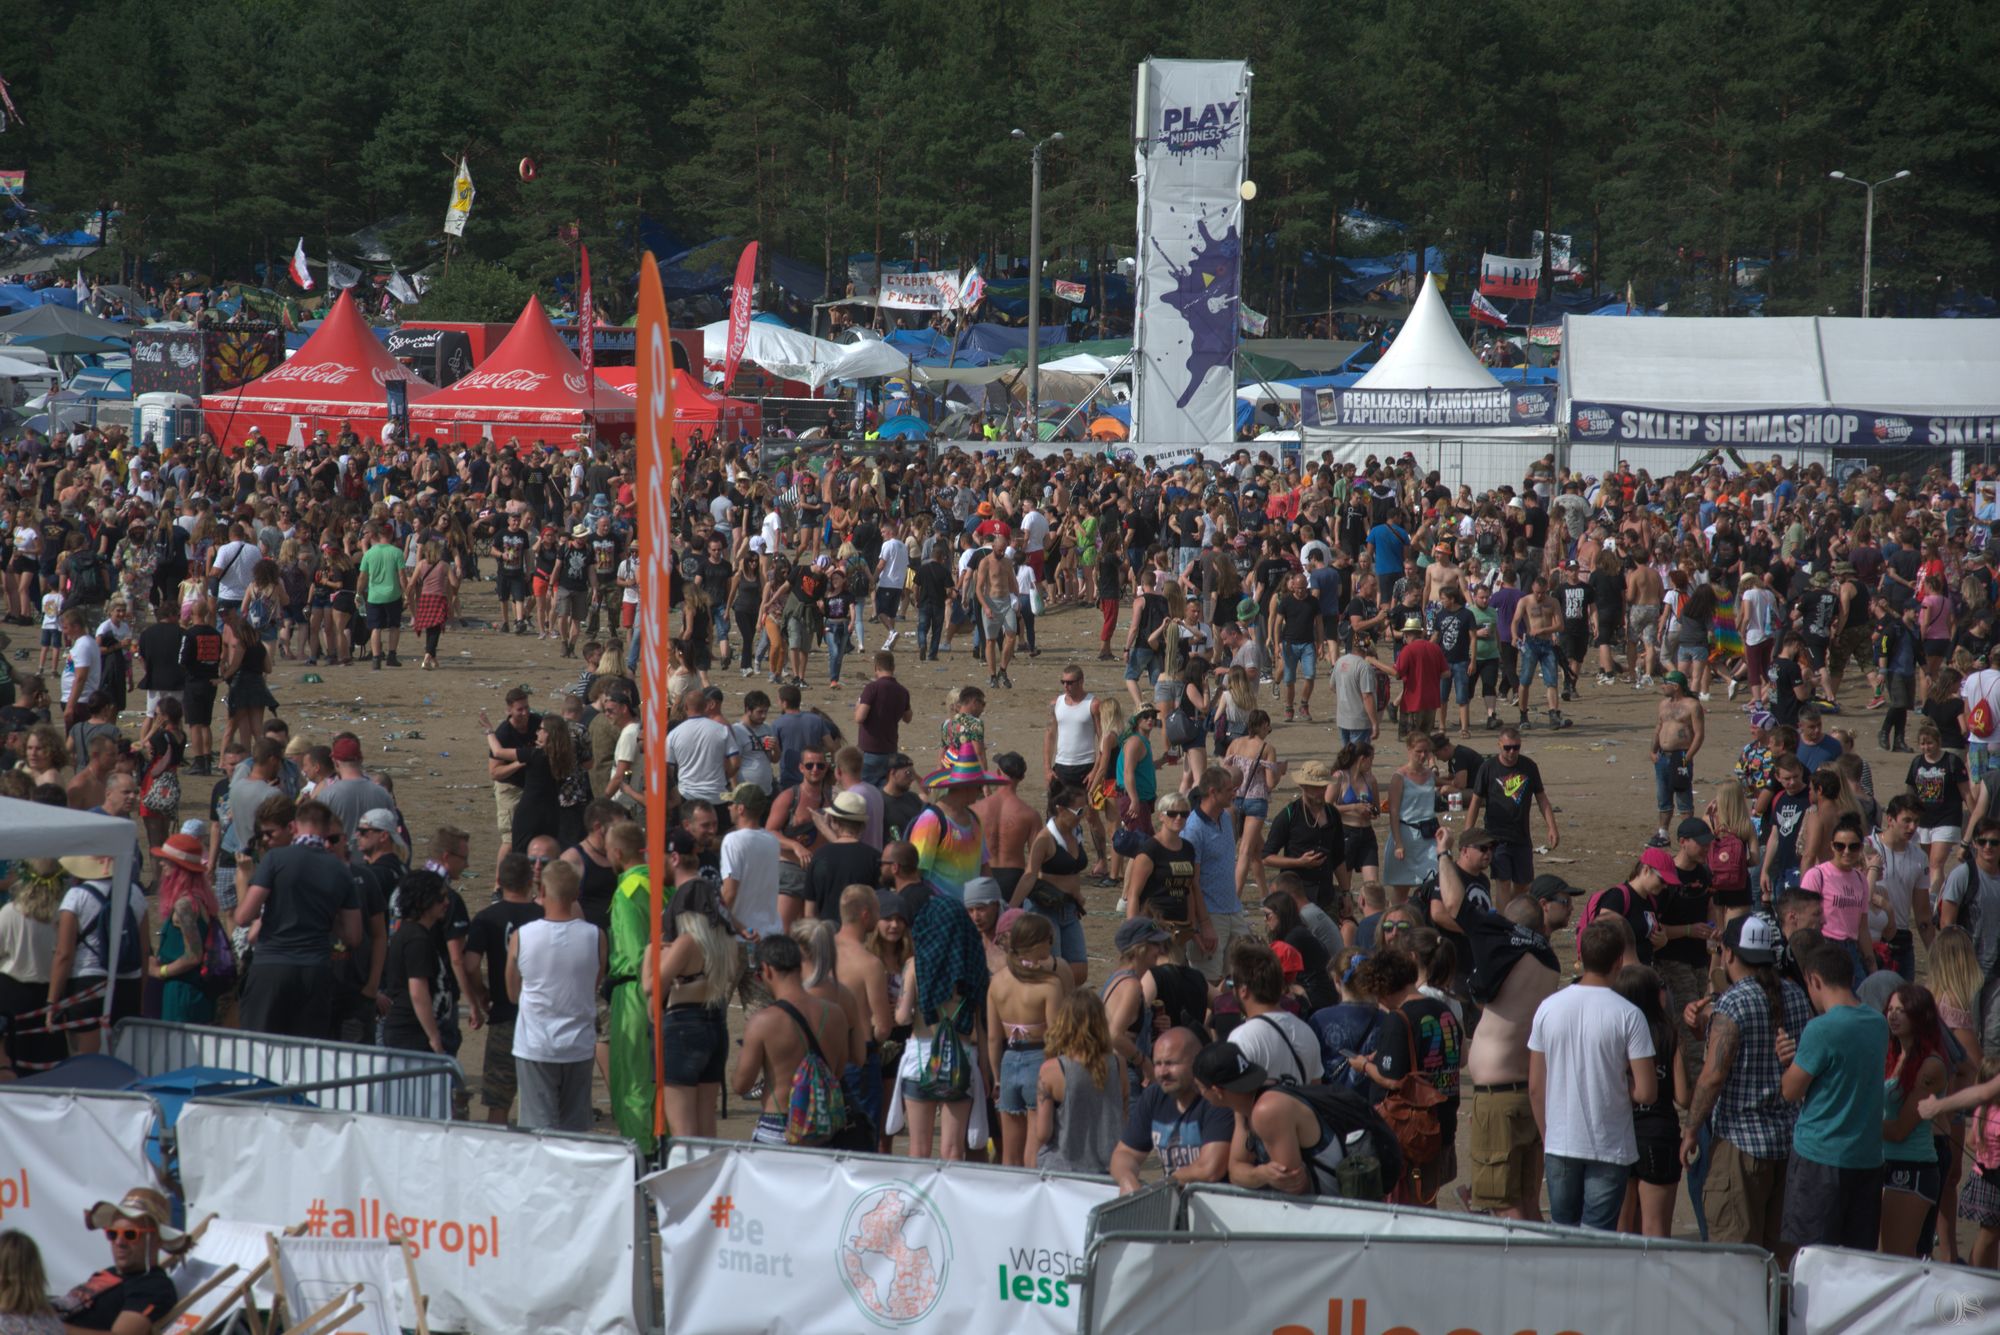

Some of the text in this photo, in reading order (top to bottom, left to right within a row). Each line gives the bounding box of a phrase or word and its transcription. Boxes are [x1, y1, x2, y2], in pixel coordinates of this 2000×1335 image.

[1163, 101, 1240, 131] PLAY
[1170, 128, 1221, 144] MUDNESS
[1343, 388, 1511, 409] REALIZACJA ZAMÓWIEŃ
[1343, 409, 1350, 424] Z
[1352, 409, 1417, 425] APLIKACJI
[1590, 419, 1615, 430] SHOP
[1621, 411, 1859, 444] SKLEP SIEMASHOP
[1888, 426, 1914, 438] SHOP
[306, 1198, 499, 1266] #allegropl
[718, 1247, 794, 1278] smart
[999, 1264, 1071, 1308] less
